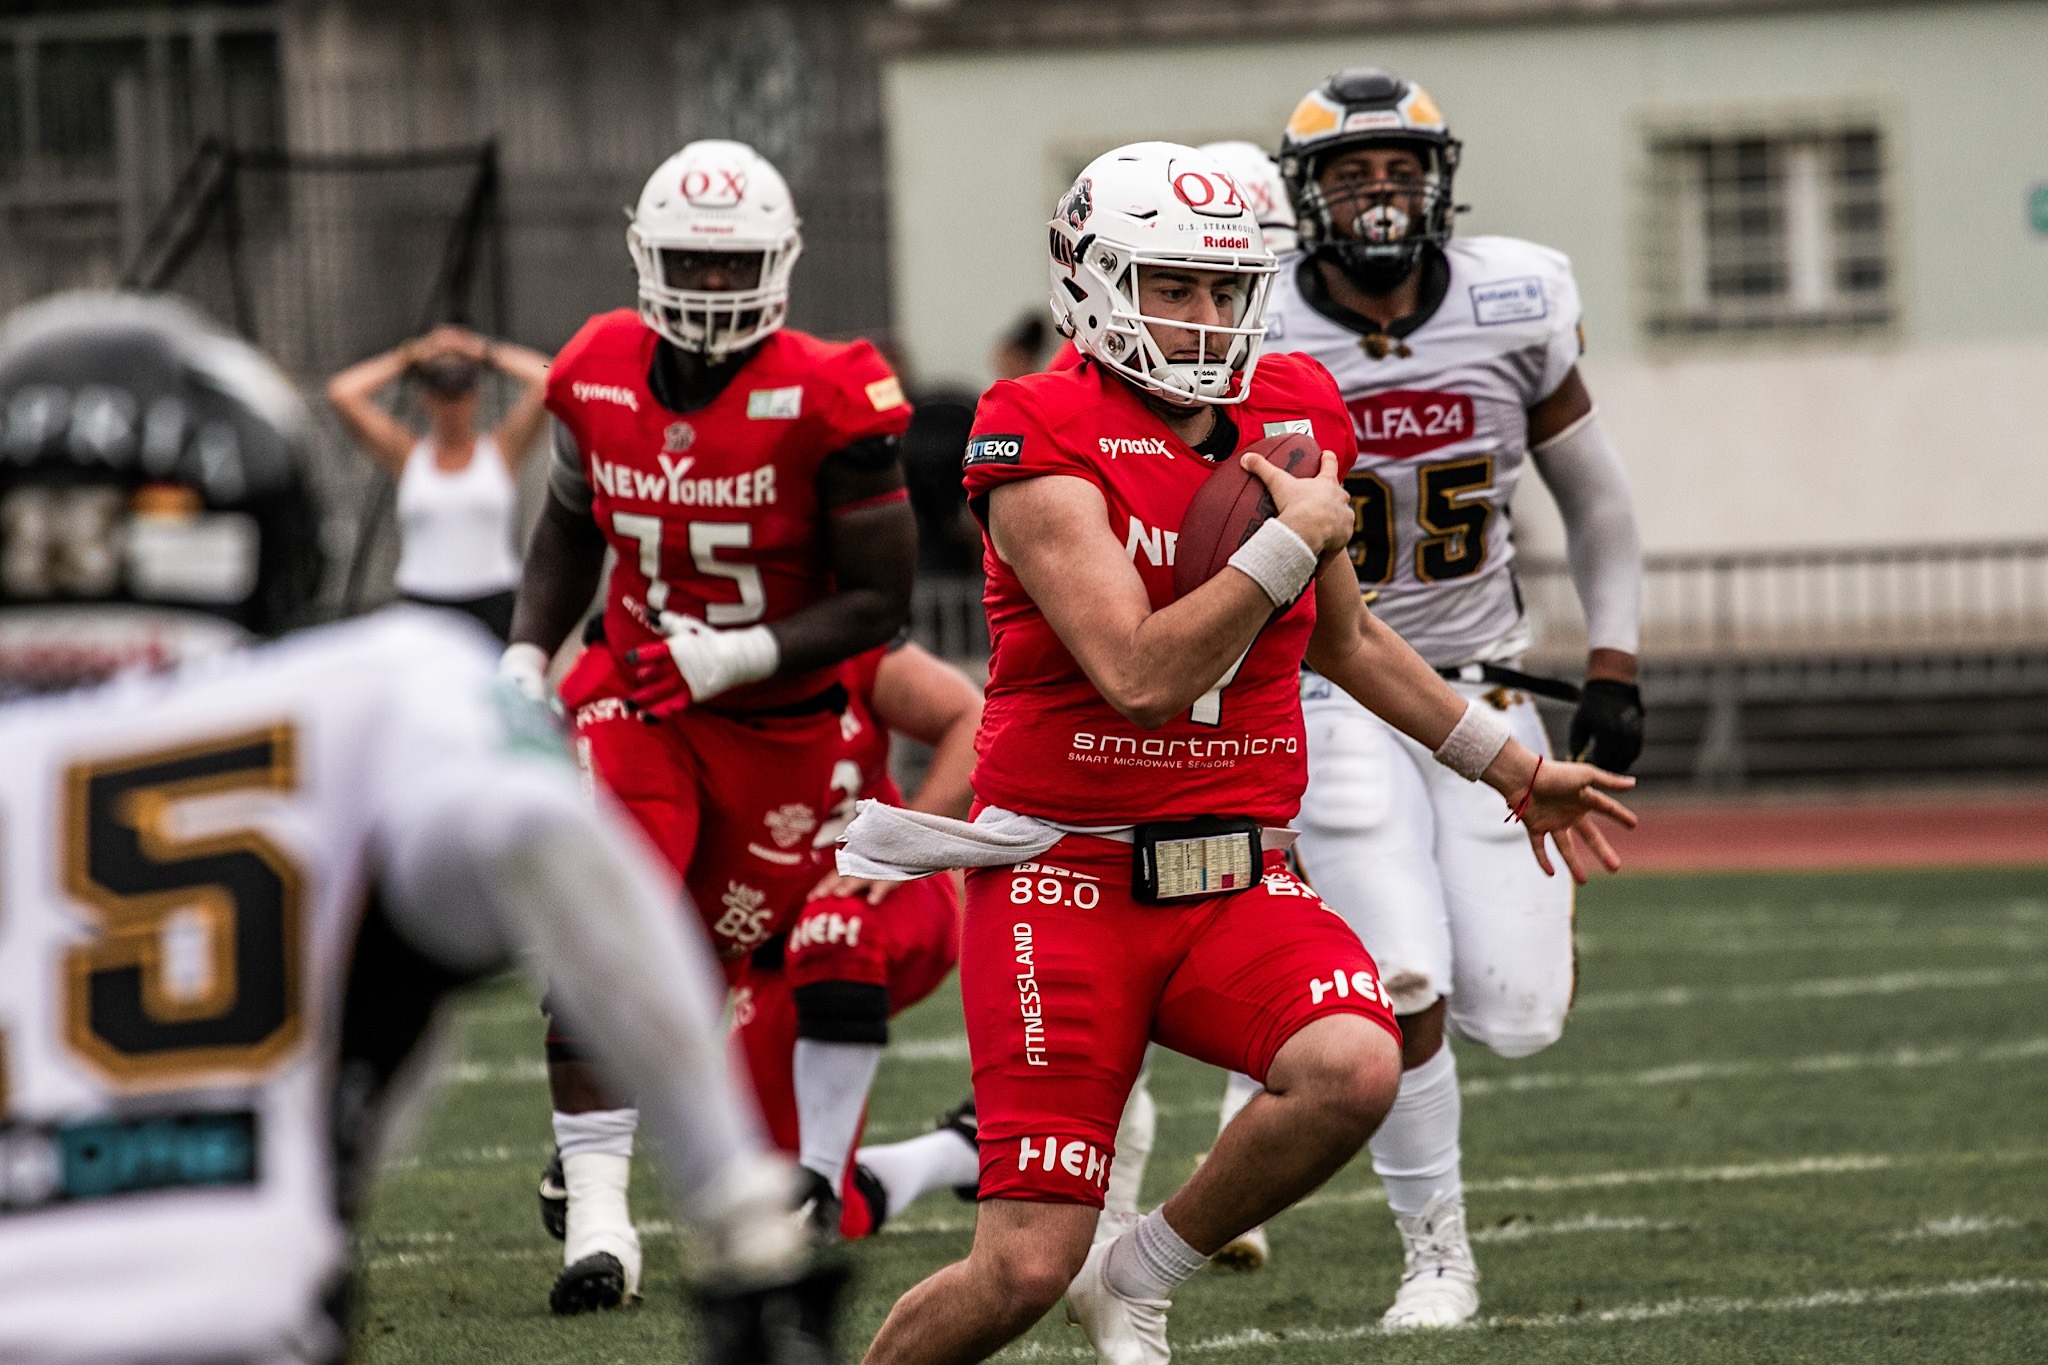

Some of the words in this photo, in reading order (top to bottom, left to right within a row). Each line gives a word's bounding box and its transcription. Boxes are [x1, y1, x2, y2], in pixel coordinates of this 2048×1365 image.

[680, 168, 746, 201] OX
[1173, 172, 1251, 212] OX
[1203, 235, 1249, 250] Riddell
[611, 510, 768, 627] 75
[1068, 752, 1109, 765] SMART
[1113, 757, 1183, 769] MICROWAVE
[1188, 759, 1236, 769] SENSORS
[1072, 731, 1298, 757] smartmicro
[62, 718, 308, 1088] 5
[1009, 877, 1101, 910] 89.0
[1013, 922, 1049, 1066] FITNESSLAND
